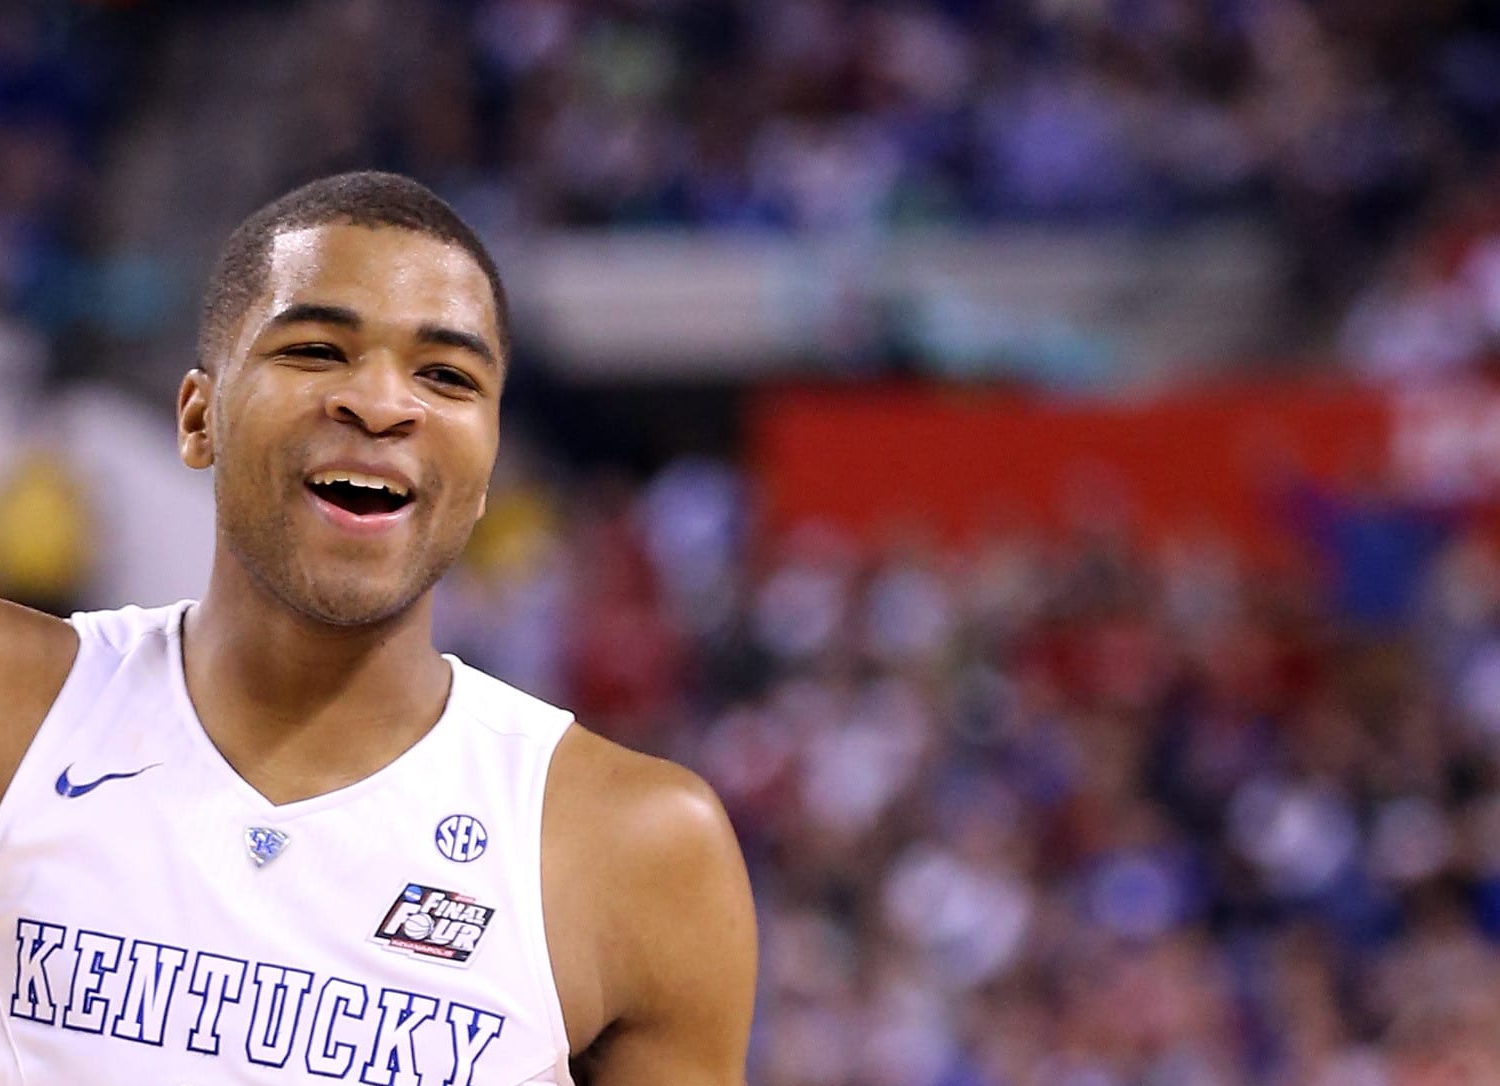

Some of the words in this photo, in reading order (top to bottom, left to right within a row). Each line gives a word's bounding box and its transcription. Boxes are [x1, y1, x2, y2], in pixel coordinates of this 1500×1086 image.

[436, 815, 487, 862] SEC
[383, 902, 481, 950] FOUR
[420, 892, 487, 924] FINAL
